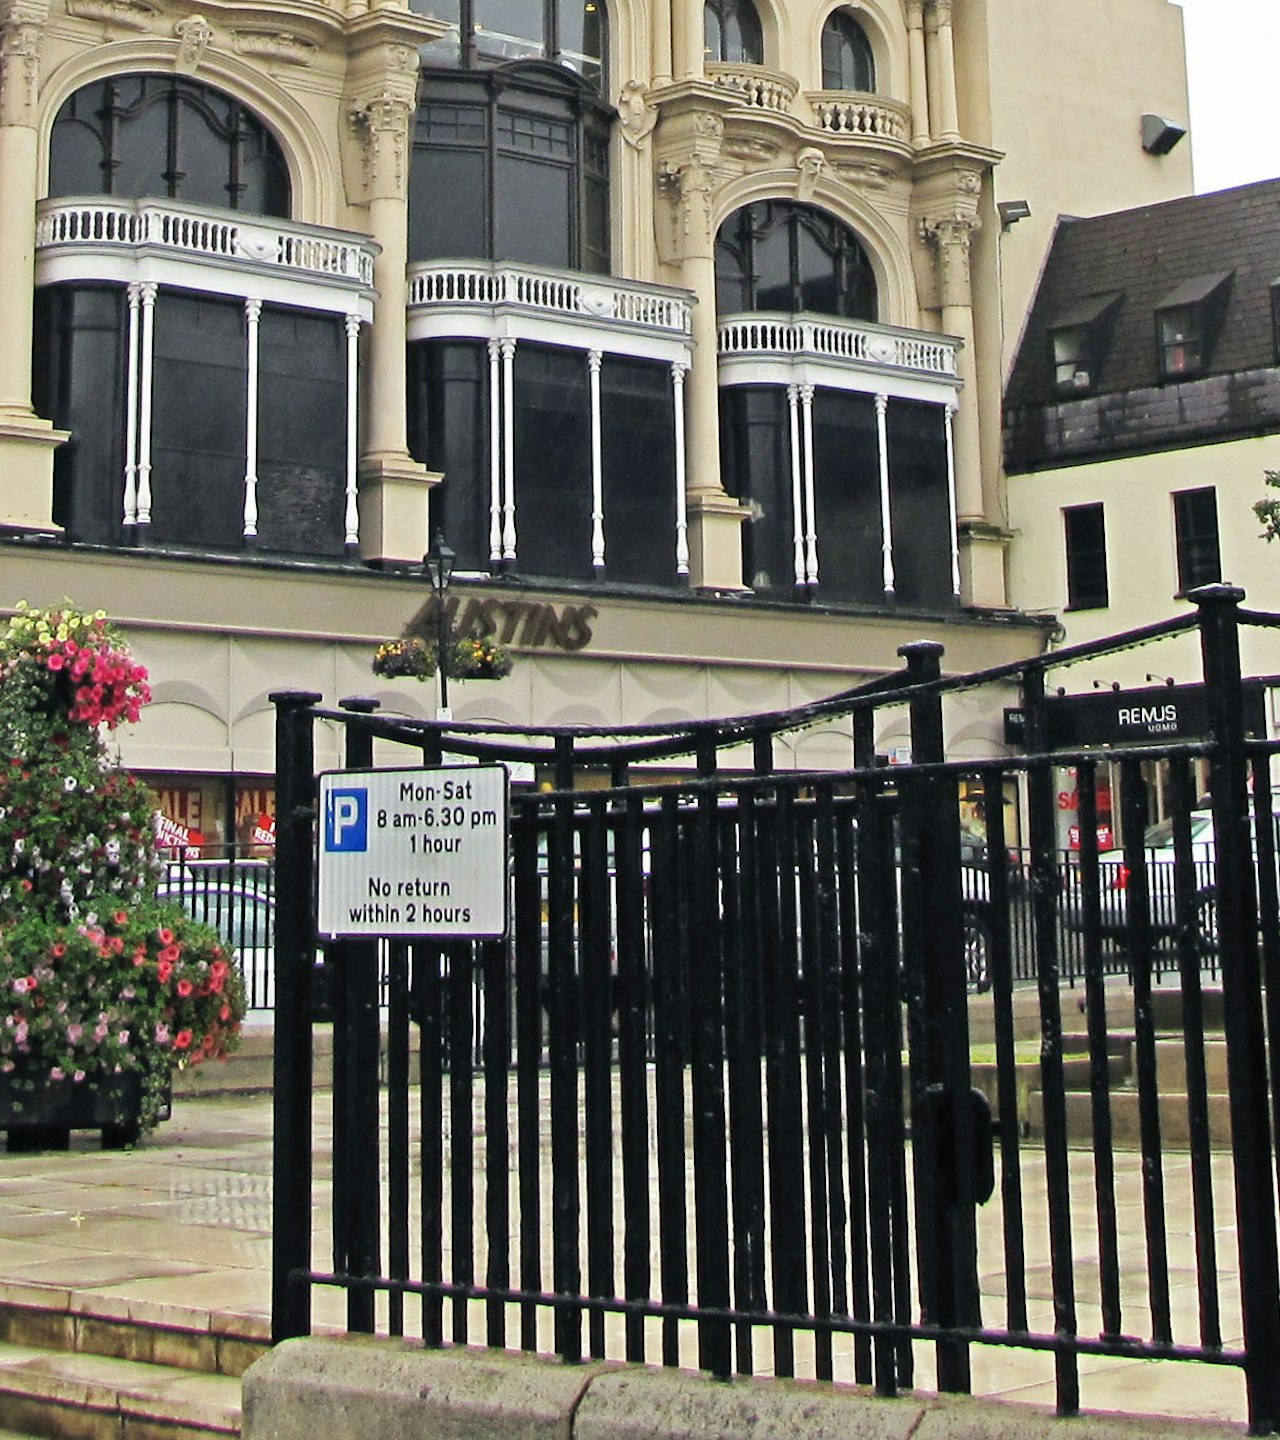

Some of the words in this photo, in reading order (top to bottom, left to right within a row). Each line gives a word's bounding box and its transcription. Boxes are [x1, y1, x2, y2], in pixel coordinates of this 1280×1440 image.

[401, 590, 599, 651] AUSTINS
[1119, 705, 1177, 725] REMUS
[1147, 723, 1178, 733] UOMO
[400, 780, 472, 802] Mon-Sat
[334, 796, 358, 845] P
[377, 809, 387, 828] 8
[393, 807, 465, 828] am-6.30
[471, 810, 497, 829] pm
[410, 835, 416, 853] 1
[423, 834, 462, 853] hour
[369, 878, 391, 896] No
[397, 878, 450, 896] return
[349, 904, 400, 923] within
[406, 904, 416, 922] 2
[423, 904, 471, 923] hours
